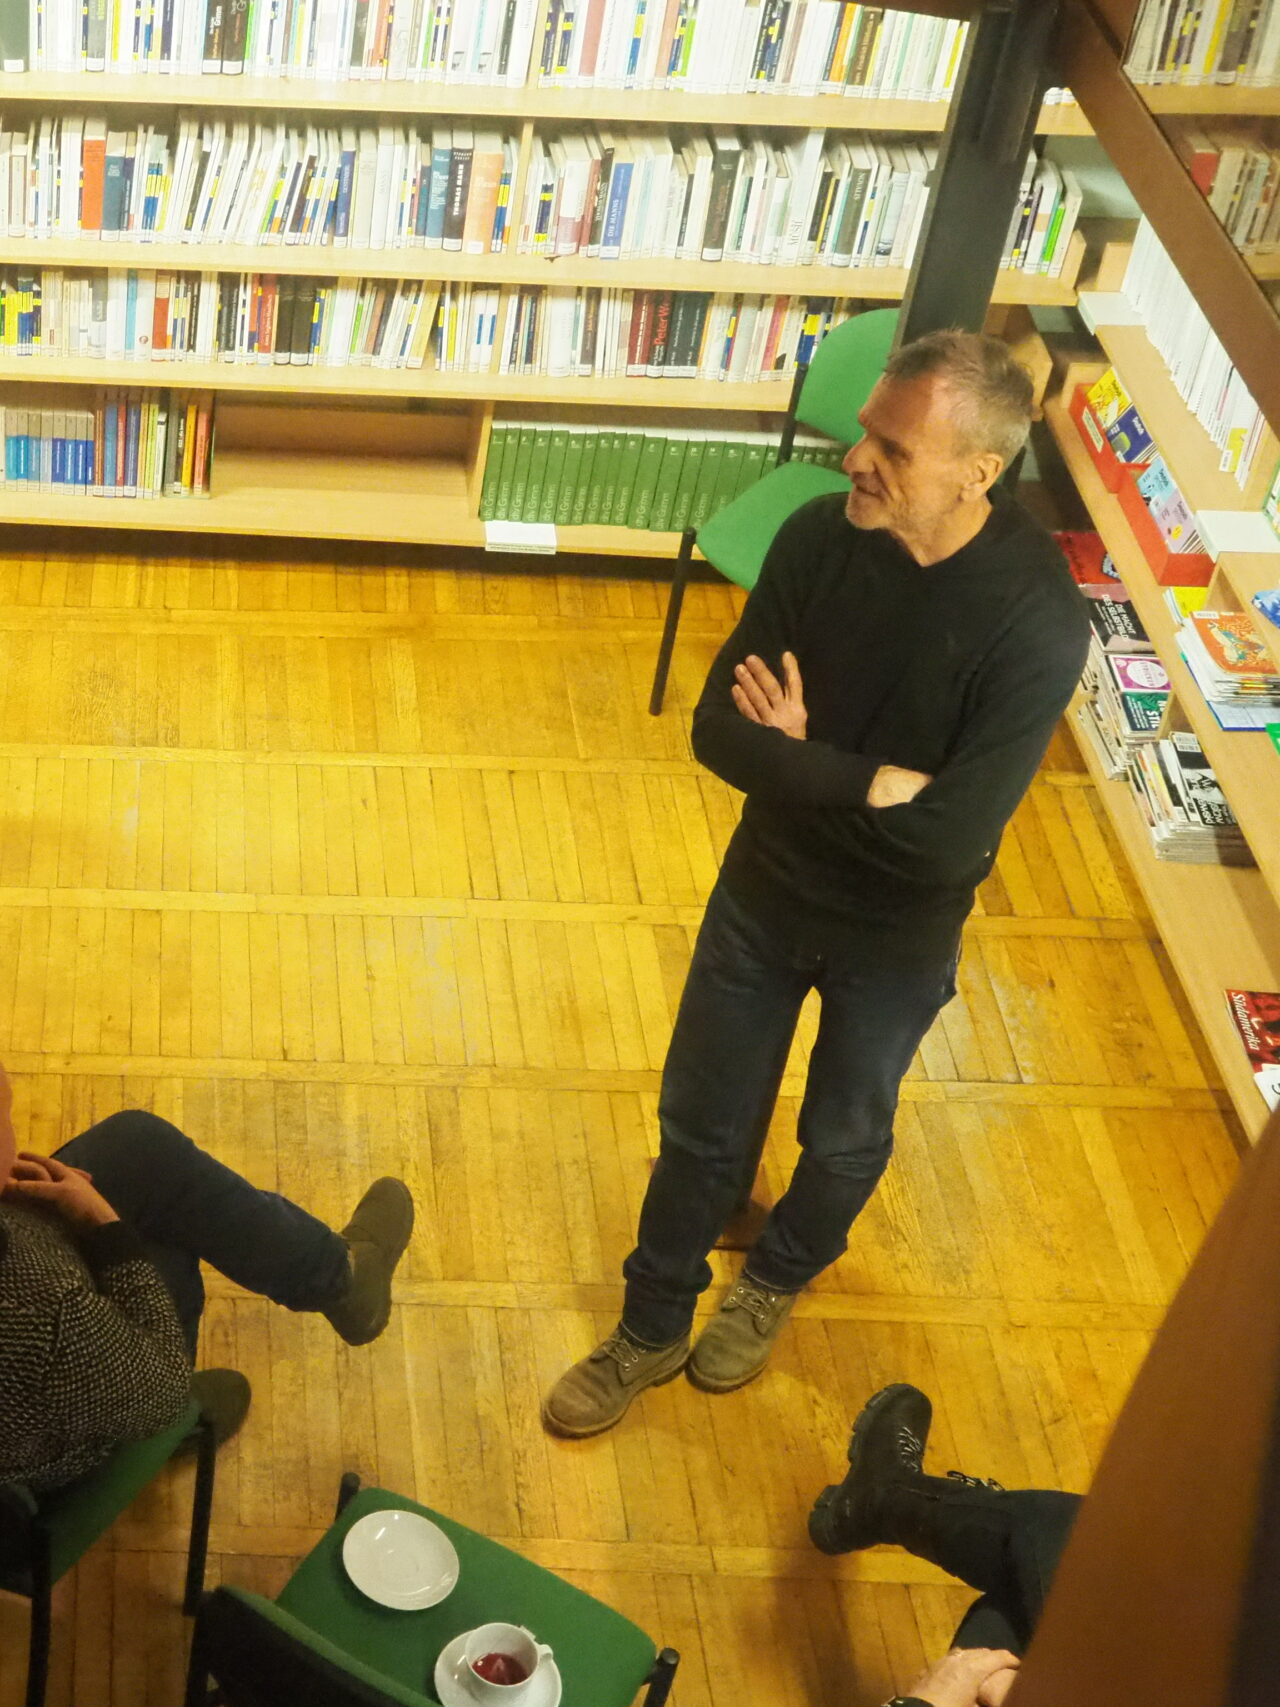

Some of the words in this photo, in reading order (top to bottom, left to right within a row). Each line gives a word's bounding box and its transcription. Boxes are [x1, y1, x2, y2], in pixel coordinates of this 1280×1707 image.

[457, 163, 465, 185] MANN
[453, 186, 462, 216] THOMAS
[654, 319, 668, 345] Peter
[1120, 613, 1137, 635] MACHT
